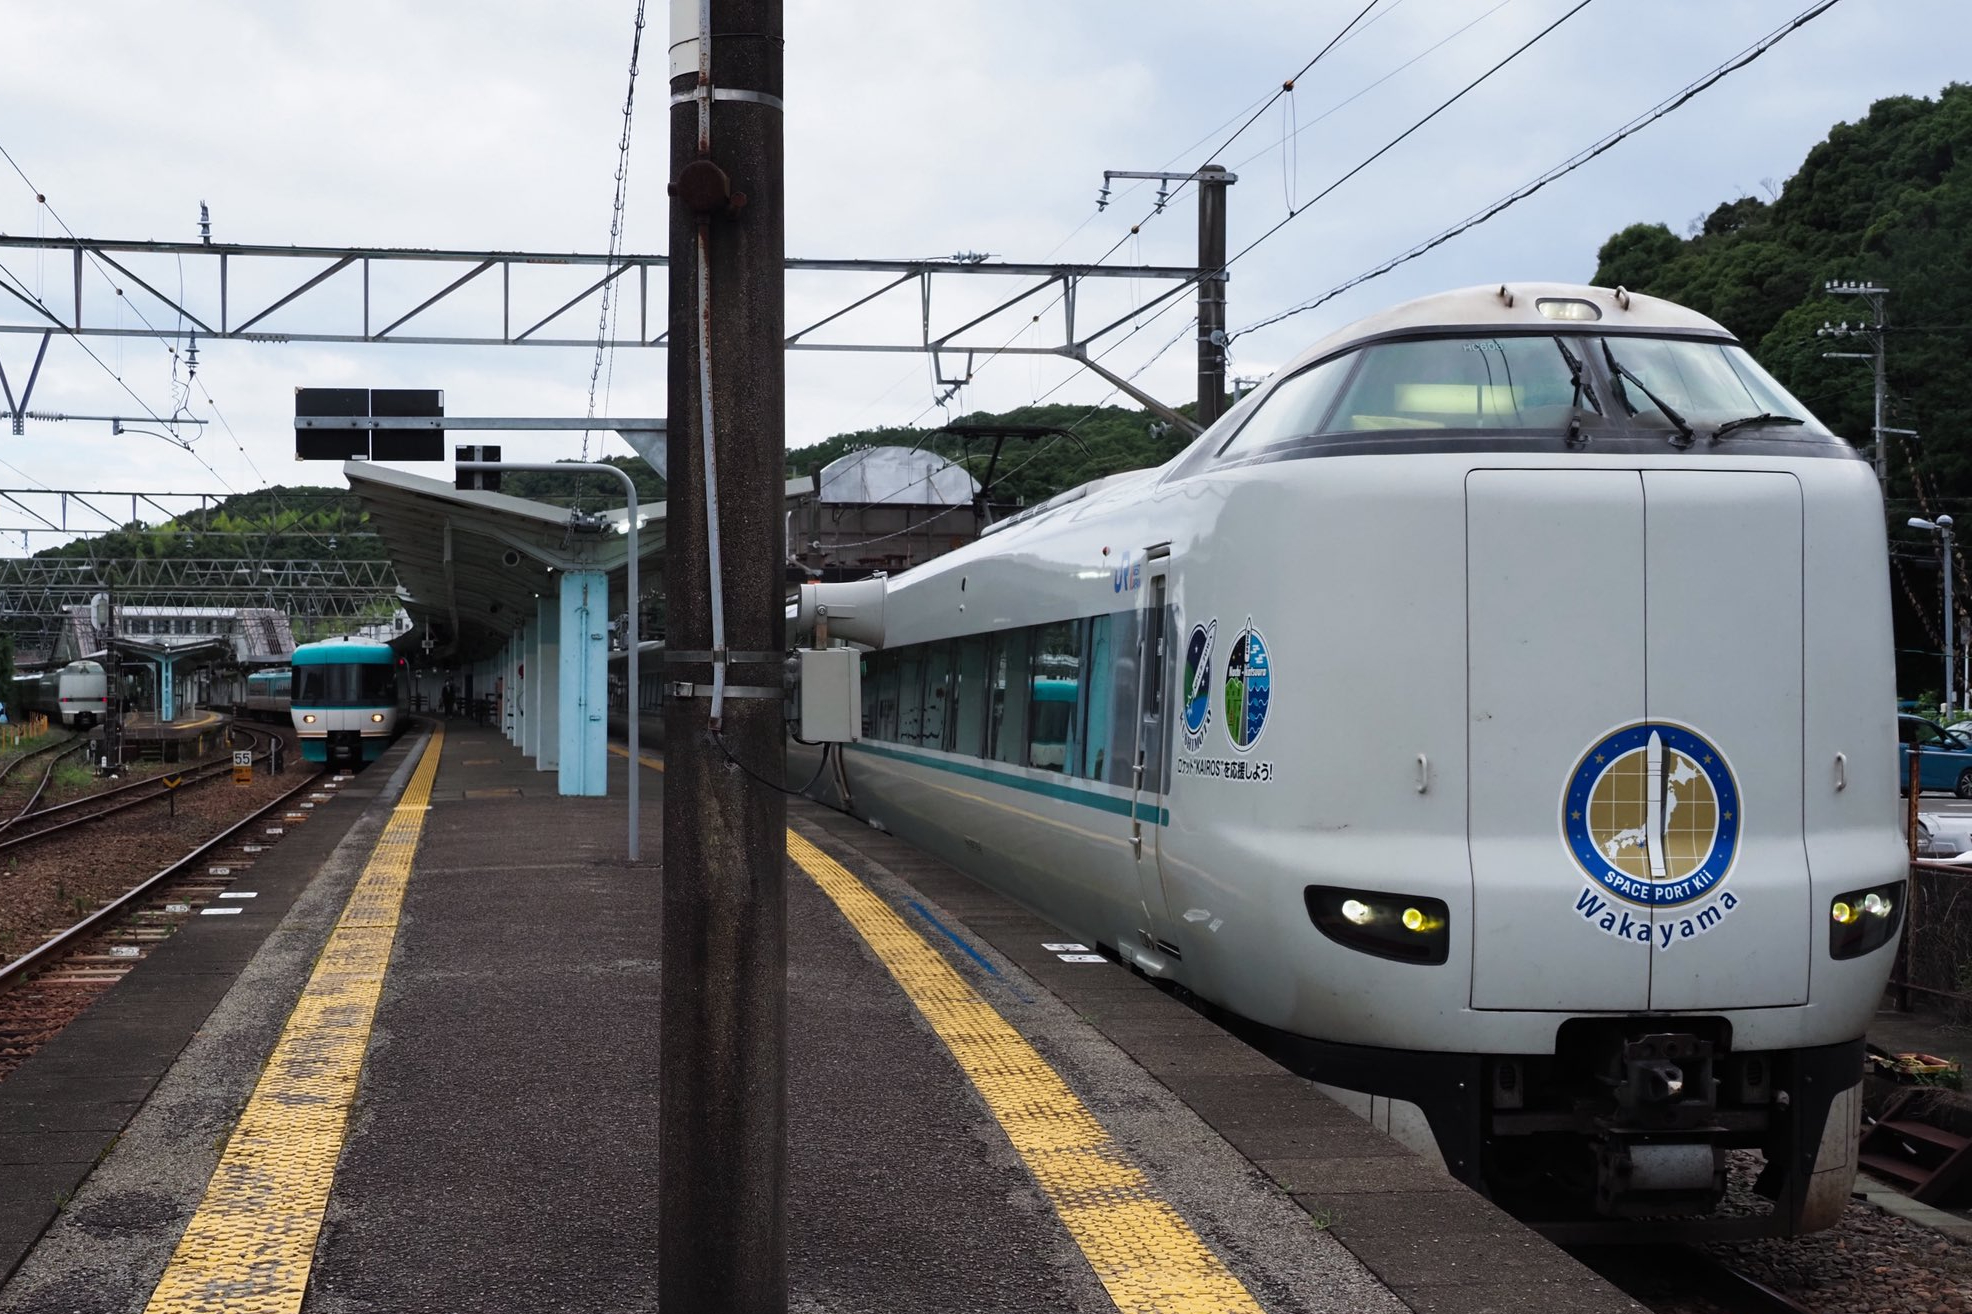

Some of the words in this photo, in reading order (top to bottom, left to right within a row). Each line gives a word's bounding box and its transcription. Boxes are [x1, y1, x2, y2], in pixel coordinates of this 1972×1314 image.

[234, 752, 250, 765] 55
[1604, 871, 1649, 900] SPACE
[1655, 881, 1691, 901] PORT
[1693, 868, 1714, 890] Kii
[1575, 887, 1738, 949] Wakayama
